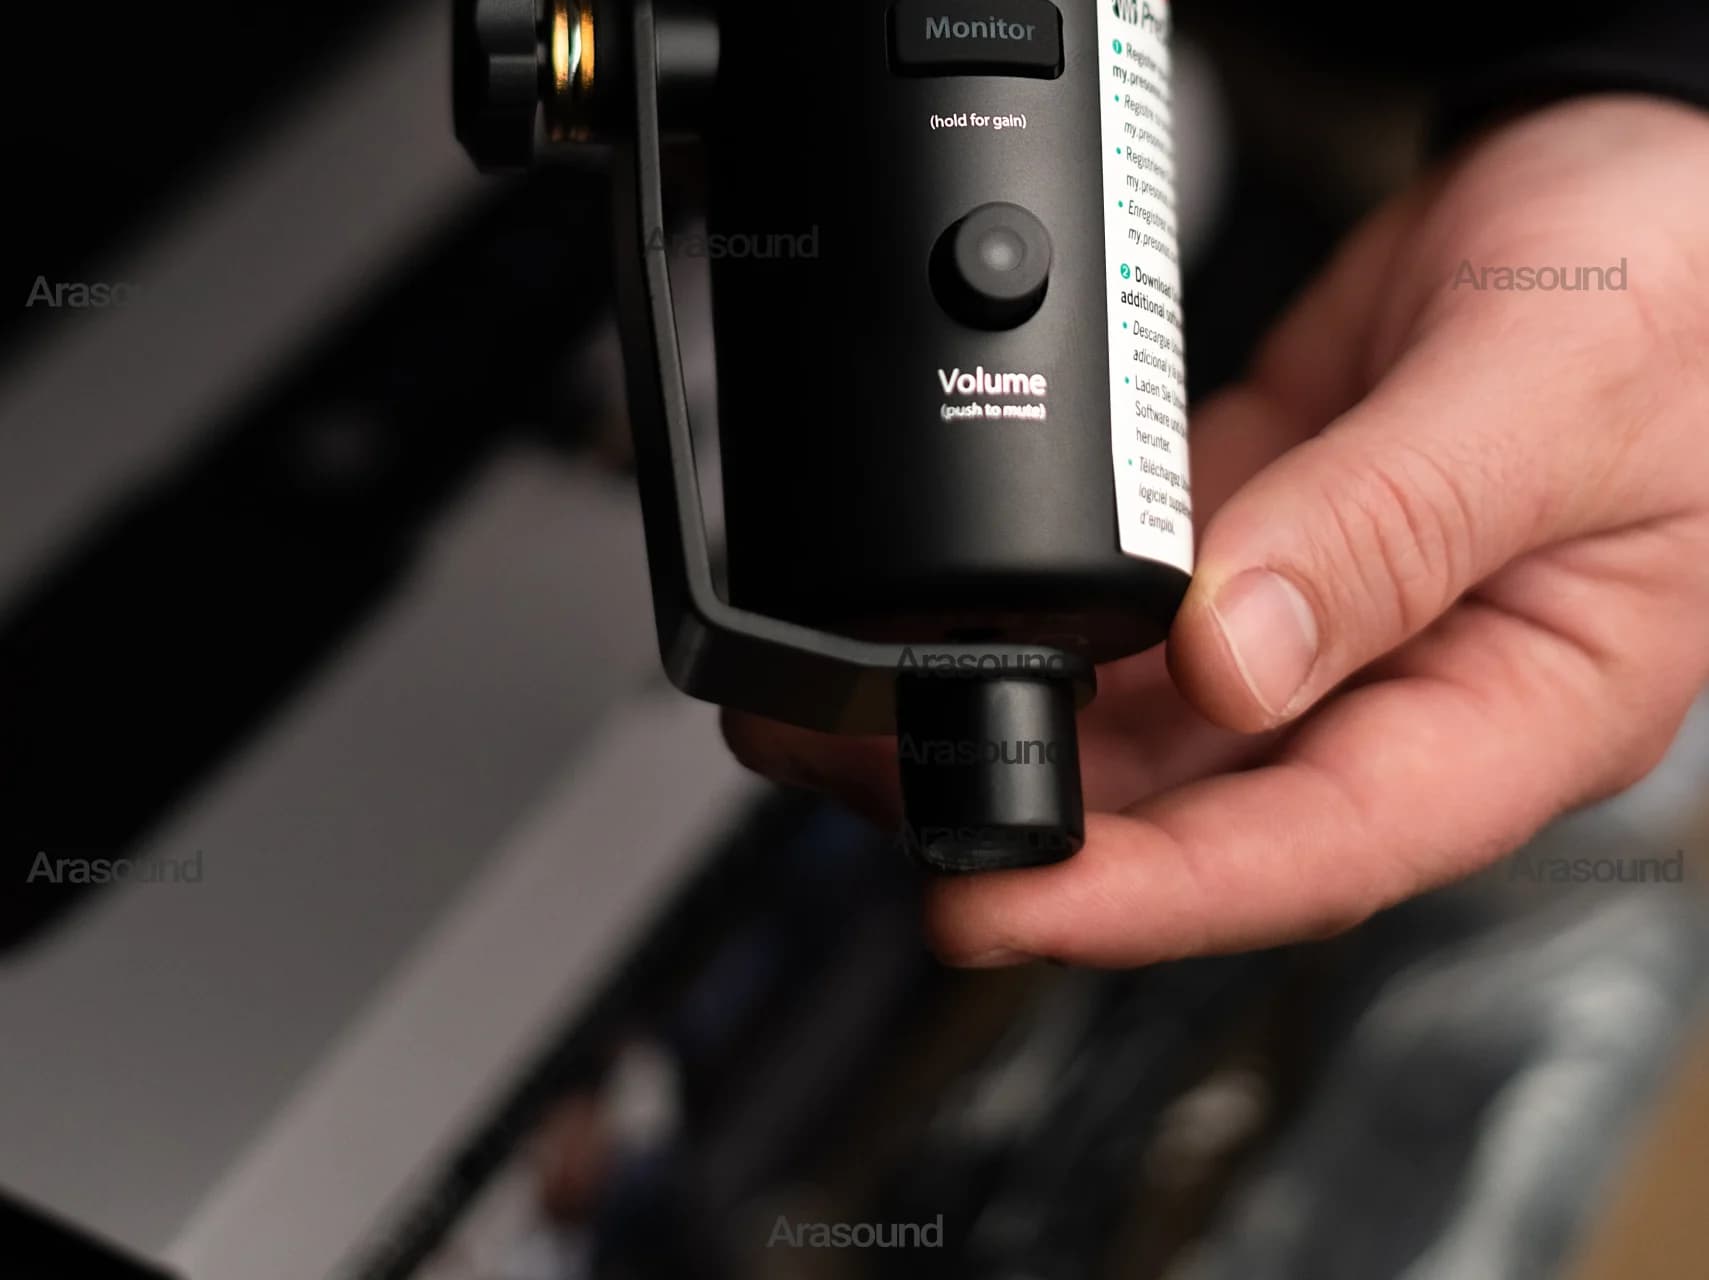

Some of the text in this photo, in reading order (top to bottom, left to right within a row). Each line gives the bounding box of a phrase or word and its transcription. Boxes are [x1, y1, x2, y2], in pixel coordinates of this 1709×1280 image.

[925, 16, 1036, 41] Monitor
[930, 112, 1027, 130] (hold for gain)
[1121, 289, 1165, 318] additional
[938, 365, 1047, 396] Volume
[941, 402, 1047, 421] (push to mute)
